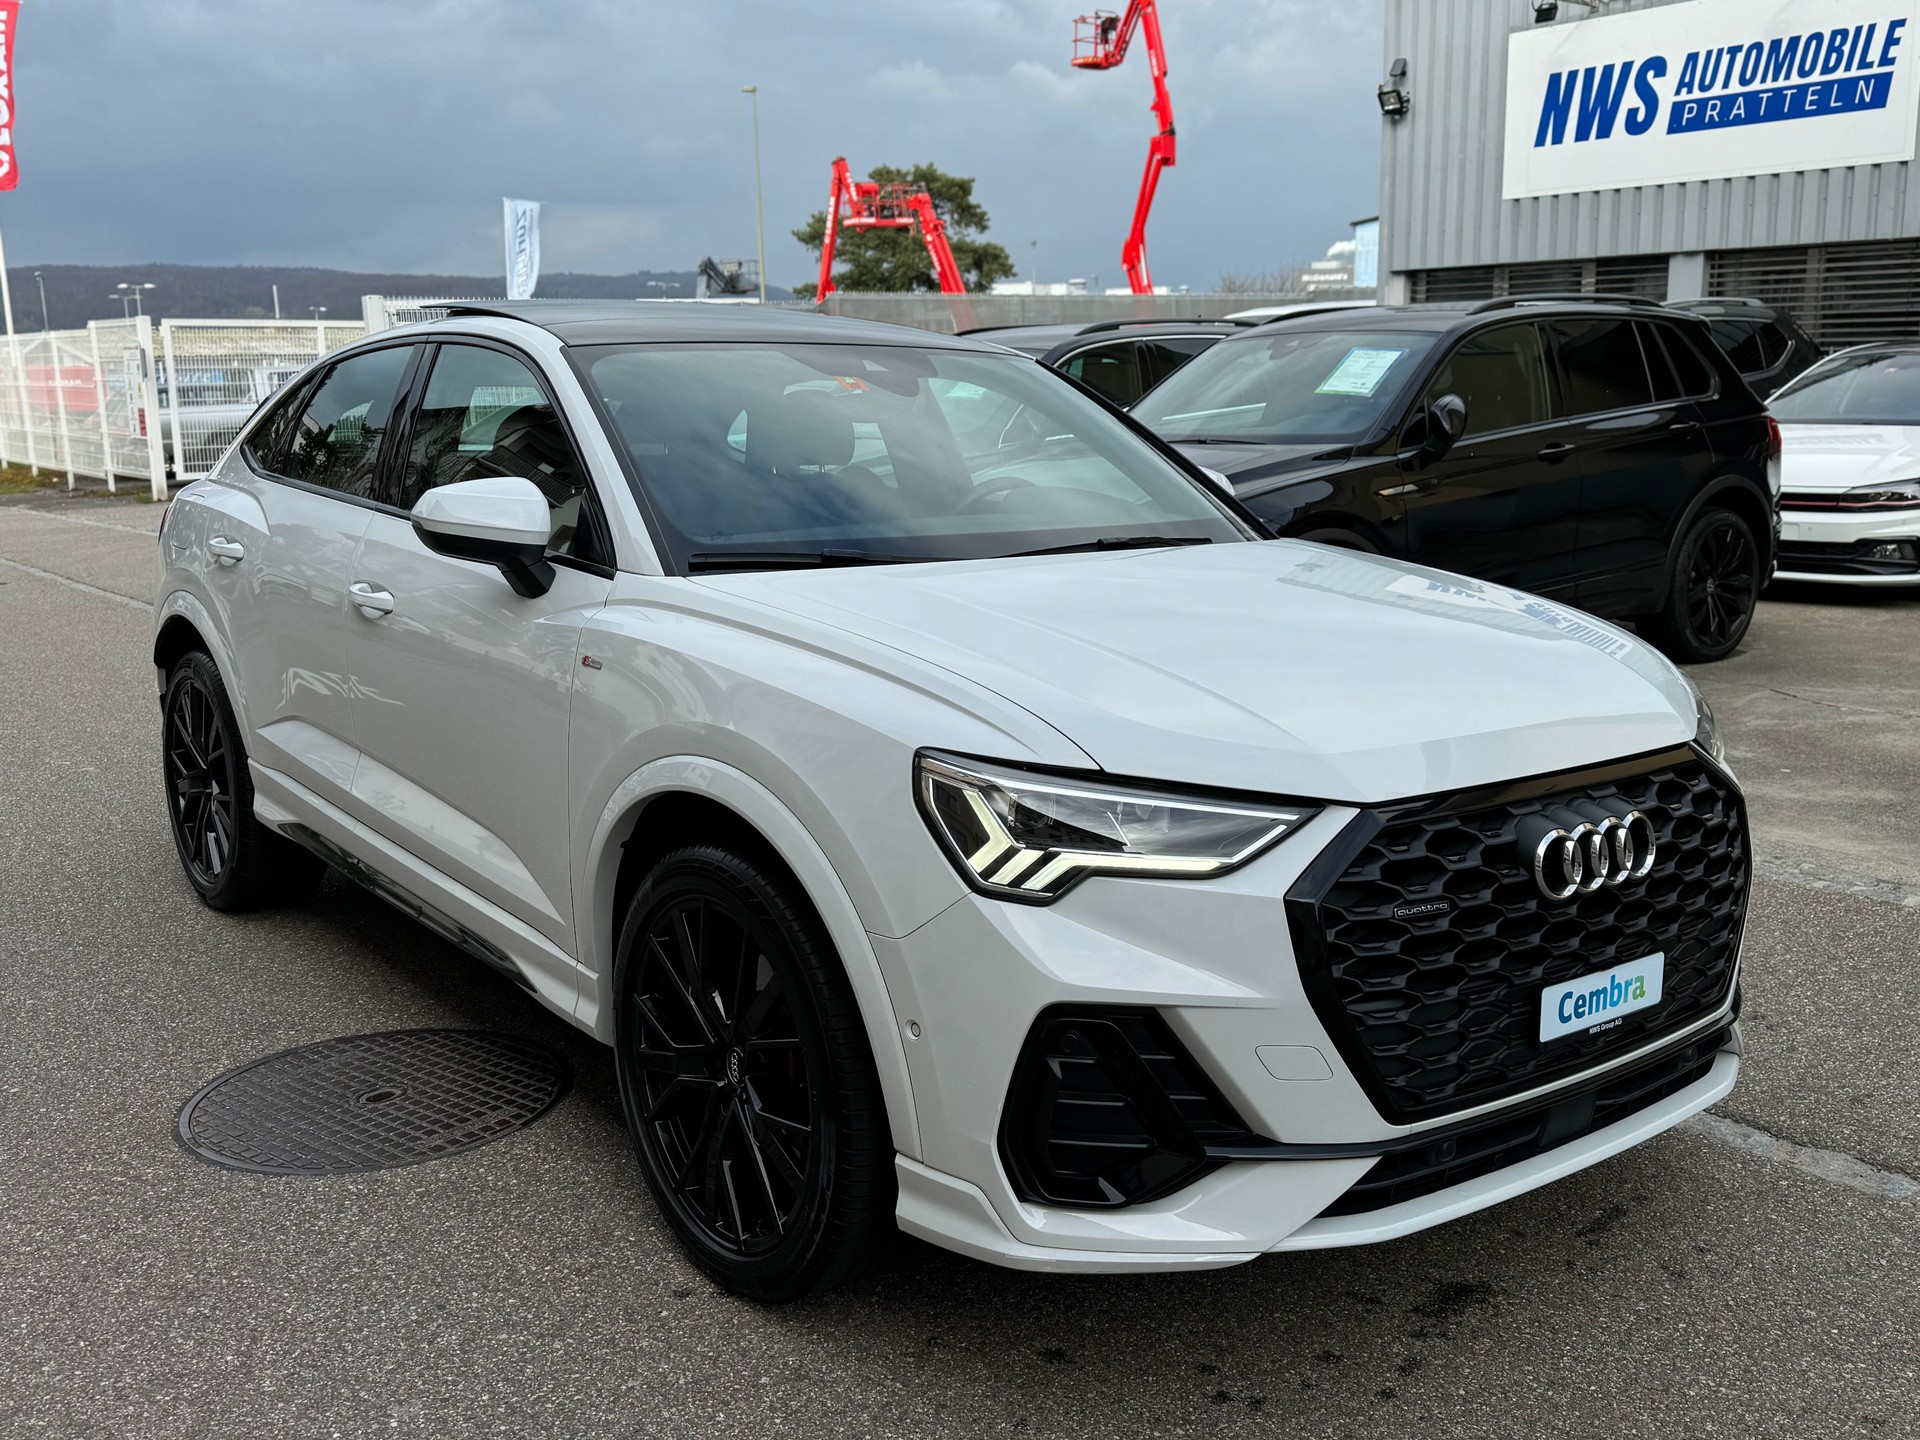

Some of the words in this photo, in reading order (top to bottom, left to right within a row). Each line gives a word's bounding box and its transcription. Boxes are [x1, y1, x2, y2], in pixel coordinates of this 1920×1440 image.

[1674, 18, 1908, 97] AUTOMOBILE
[1534, 55, 1668, 148] NWS
[1682, 78, 1876, 127] PRATTELN
[1398, 904, 1447, 917] quattro
[1558, 974, 1646, 1024] Cembra
[1589, 1025, 1600, 1034] NWS
[1600, 1021, 1614, 1032] Group
[1614, 1018, 1622, 1027] AG
